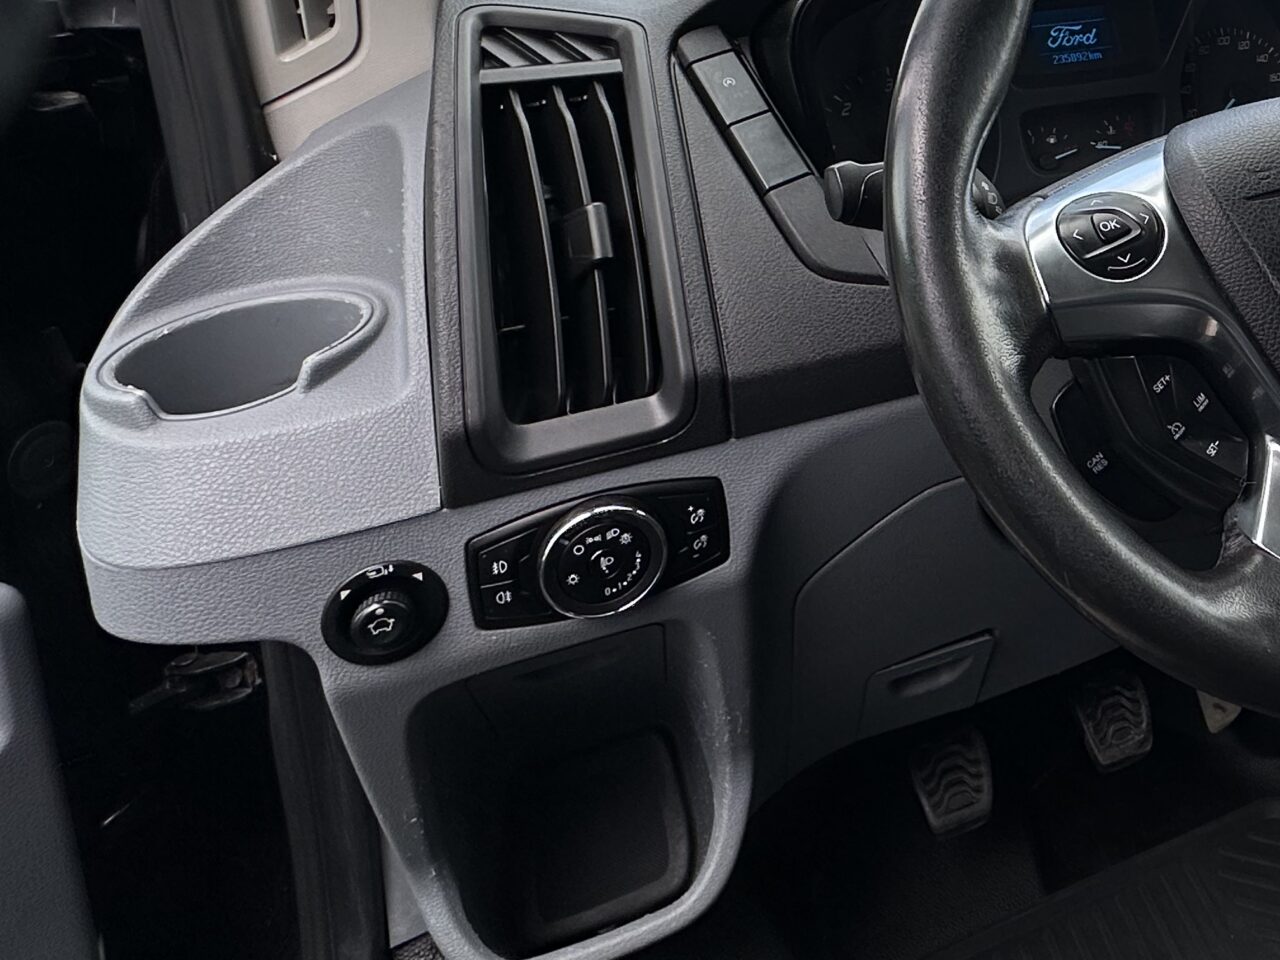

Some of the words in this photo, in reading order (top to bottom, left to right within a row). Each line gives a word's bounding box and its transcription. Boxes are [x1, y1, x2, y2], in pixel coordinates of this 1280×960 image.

[1048, 25, 1098, 48] Ford
[841, 102, 852, 117] 2
[1100, 218, 1121, 232] OK
[1152, 374, 1171, 394] SET+
[1086, 451, 1104, 468] CAN
[1092, 458, 1108, 474] RES
